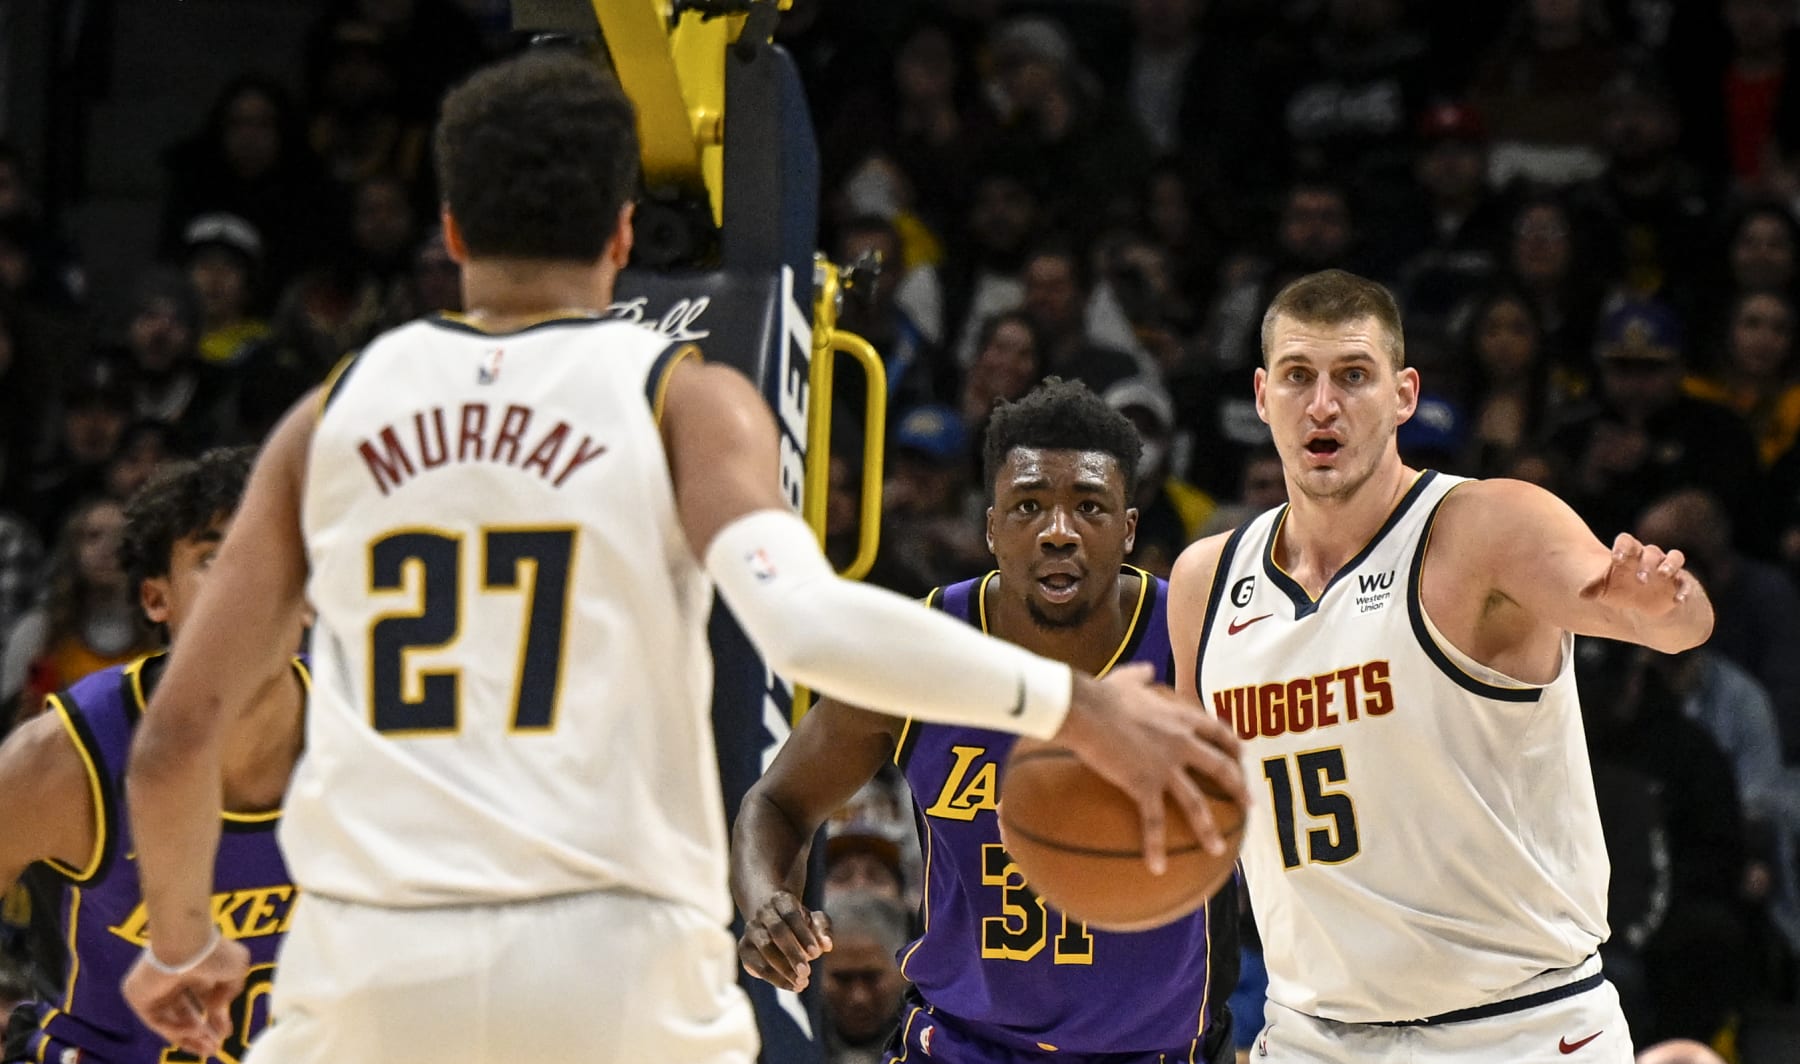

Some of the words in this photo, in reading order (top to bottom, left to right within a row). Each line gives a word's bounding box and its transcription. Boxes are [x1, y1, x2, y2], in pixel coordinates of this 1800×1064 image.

[357, 402, 607, 496] MURRAY
[1355, 592, 1391, 605] Western
[1358, 570, 1395, 594] WU
[1360, 602, 1384, 613] Union
[367, 524, 582, 738] 27
[1212, 659, 1395, 742] NUGGETS
[1261, 745, 1362, 873] 15
